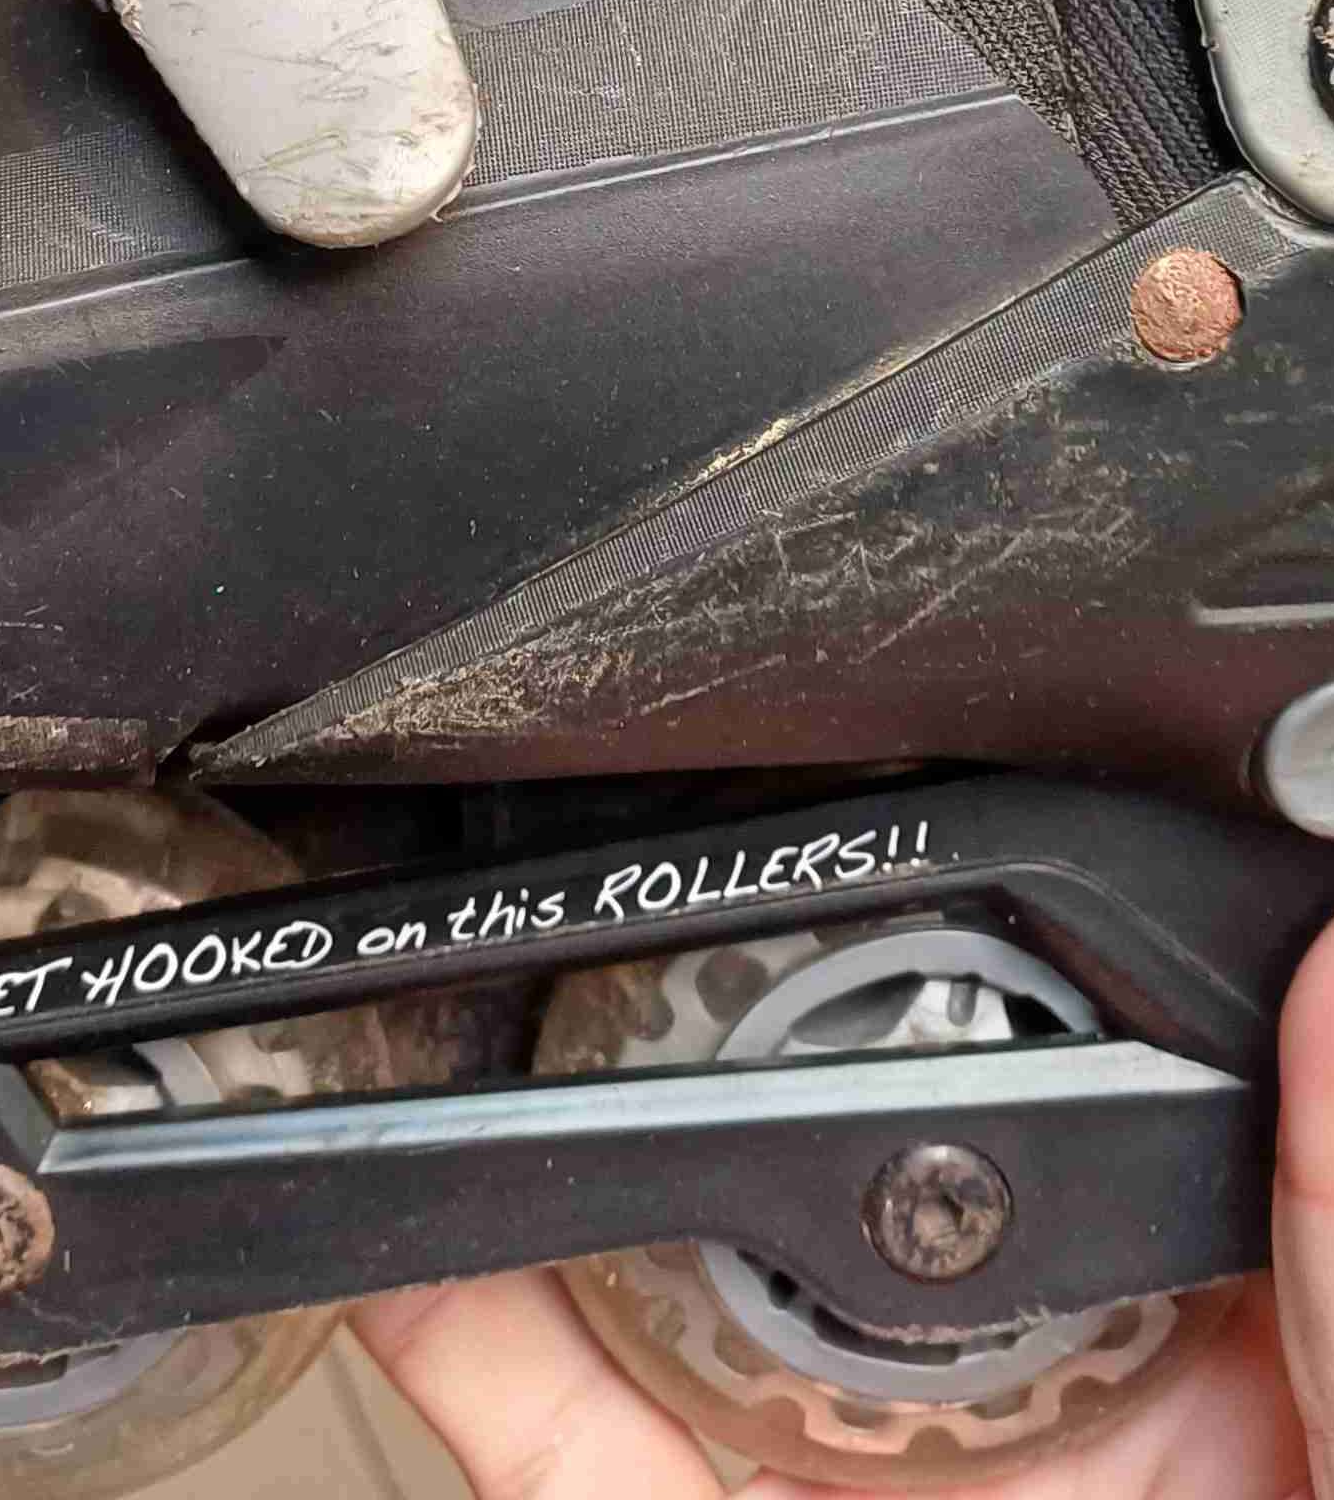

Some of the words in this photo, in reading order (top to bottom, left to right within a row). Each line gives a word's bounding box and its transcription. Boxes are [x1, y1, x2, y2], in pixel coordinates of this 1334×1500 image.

[81, 920, 334, 1007] HOOKED
[356, 920, 428, 956] on
[446, 888, 566, 942] this
[593, 819, 929, 924] ROLLERS!!
